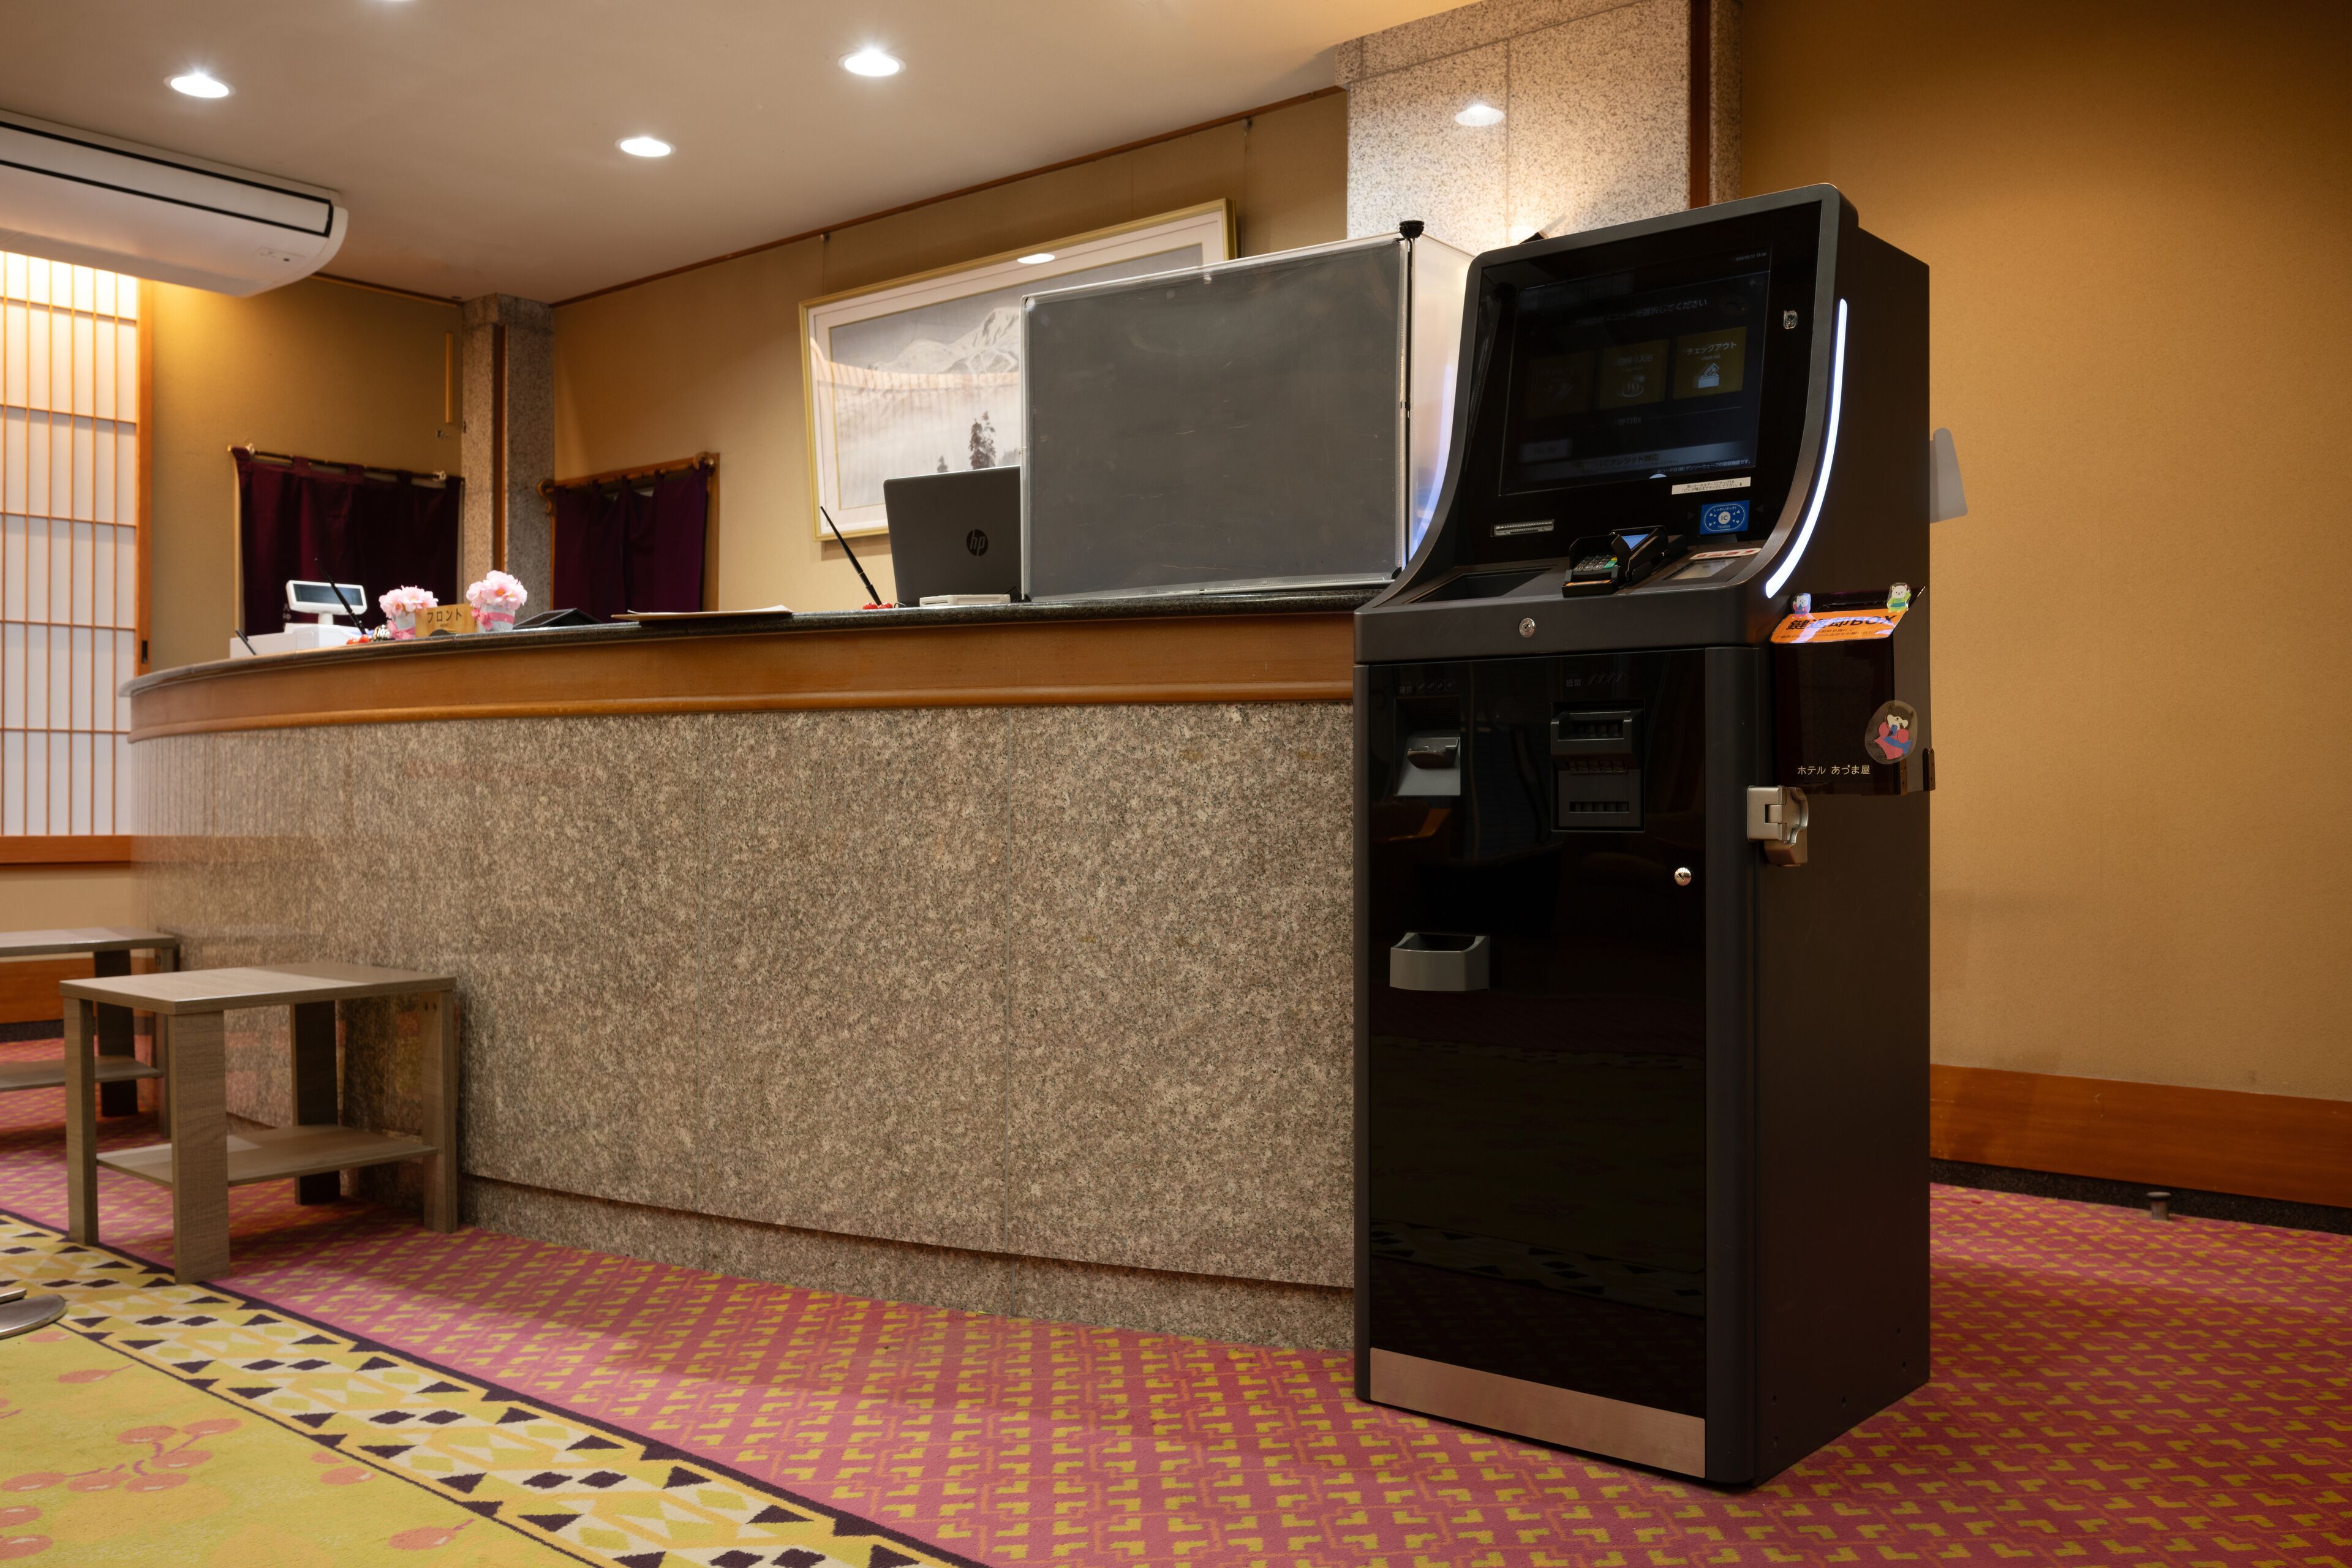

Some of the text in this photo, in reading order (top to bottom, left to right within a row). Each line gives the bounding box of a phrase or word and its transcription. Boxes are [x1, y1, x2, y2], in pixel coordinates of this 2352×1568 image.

[1686, 341, 1737, 355] チェックアウト
[1618, 417, 1642, 426] OPTION
[970, 529, 986, 556] hp
[427, 608, 462, 624] フロント
[1785, 615, 1898, 630] 鍵返却BOX
[1797, 764, 1871, 775] ホテル あづま屋
